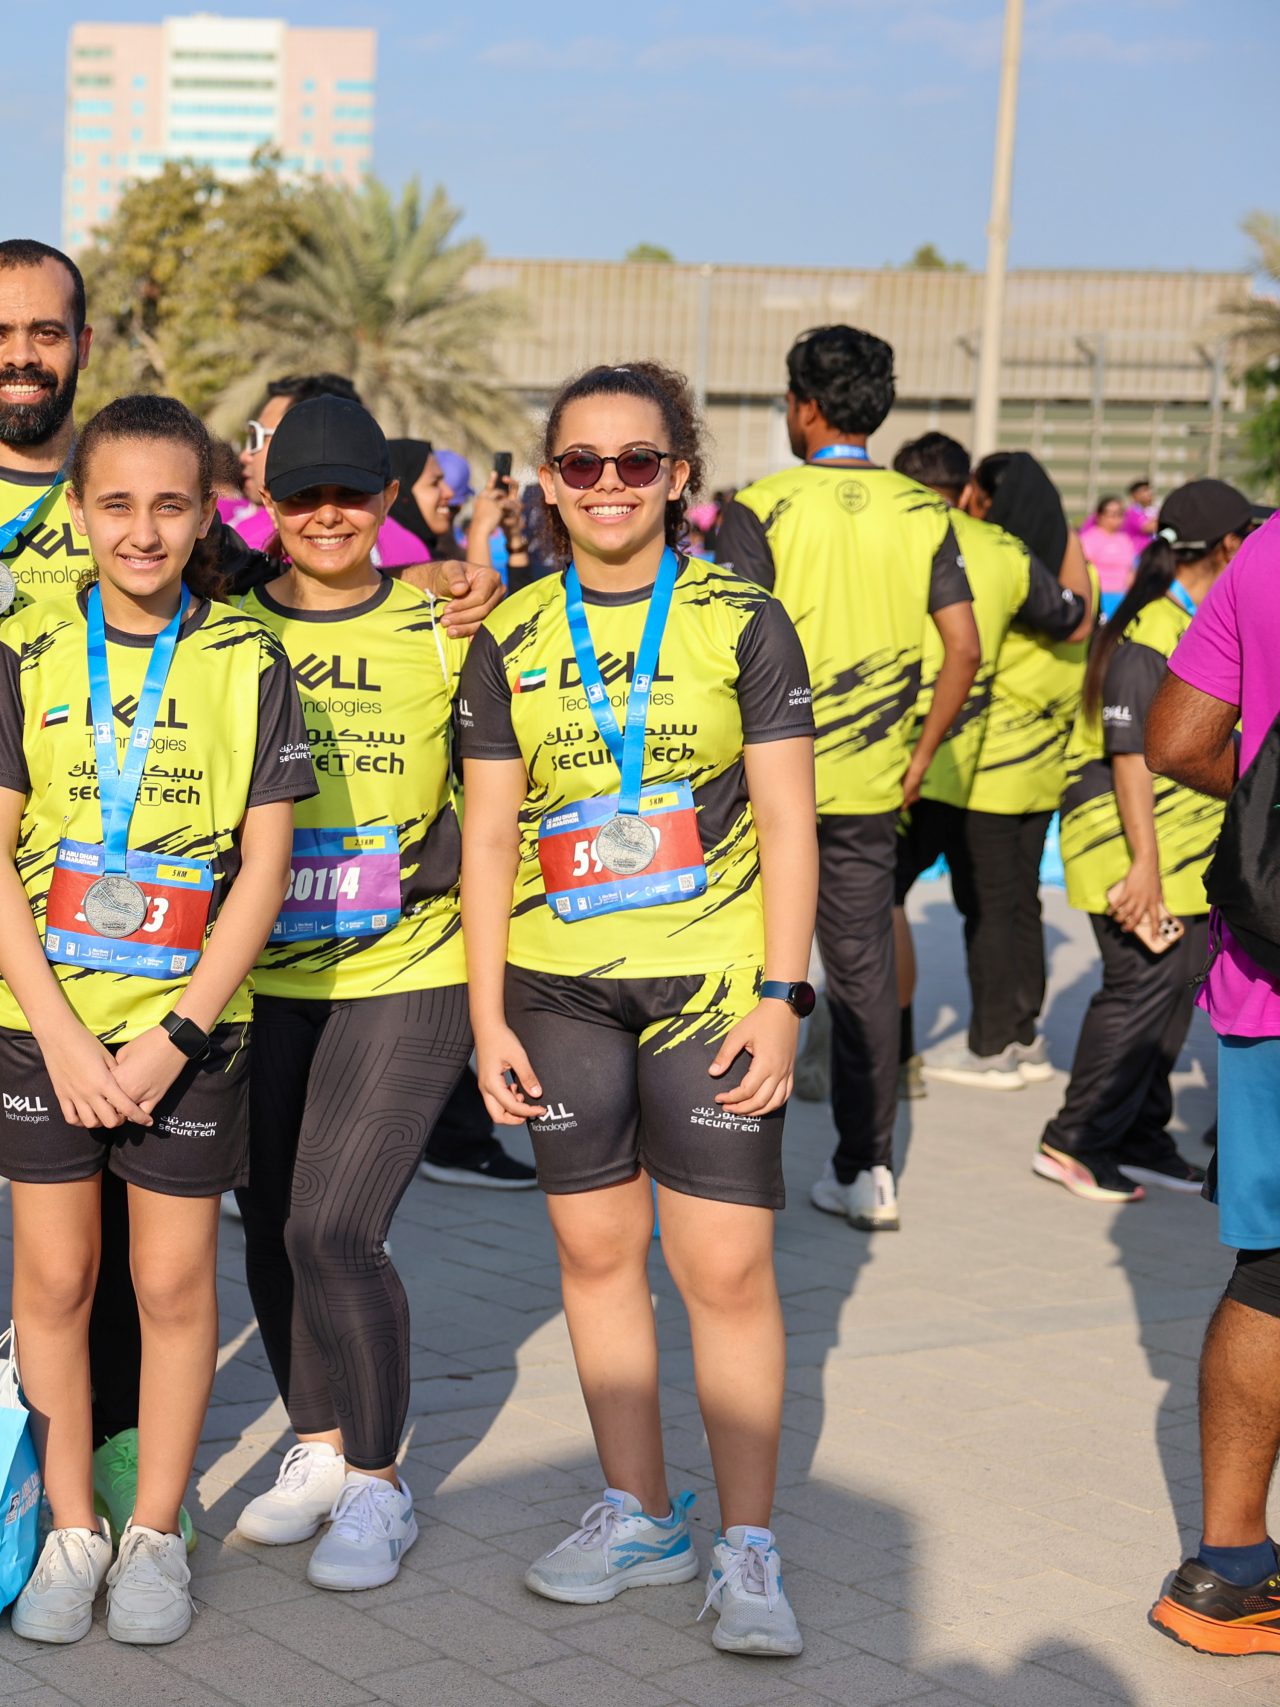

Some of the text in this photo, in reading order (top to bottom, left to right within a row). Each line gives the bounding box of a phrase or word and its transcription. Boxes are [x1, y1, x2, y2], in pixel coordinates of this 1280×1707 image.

[292, 653, 382, 692] ELL
[303, 697, 382, 717] nologies
[2, 1092, 49, 1112] DELL
[539, 1102, 575, 1121] LL
[4, 1110, 50, 1124] Technologies
